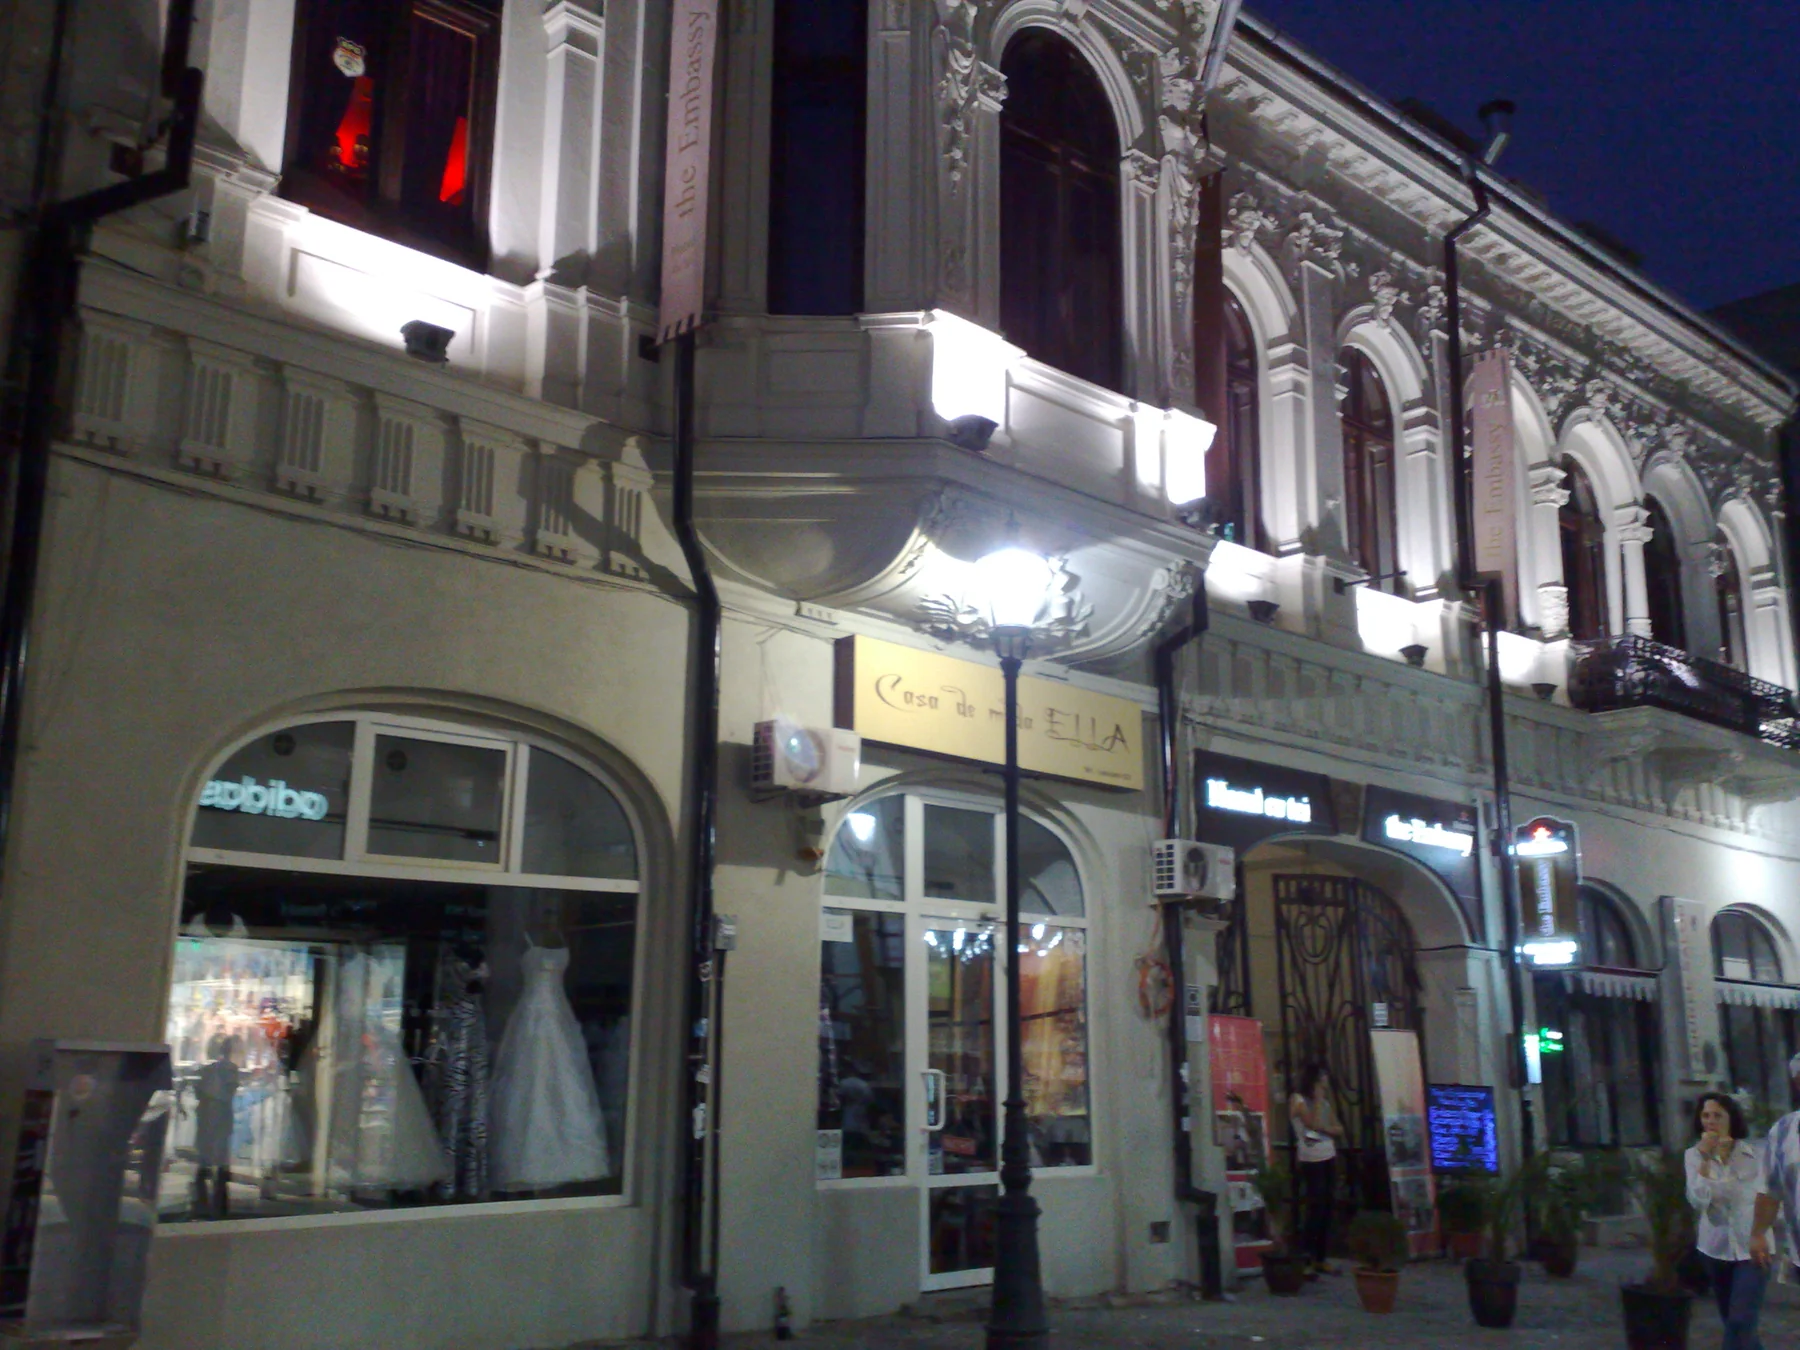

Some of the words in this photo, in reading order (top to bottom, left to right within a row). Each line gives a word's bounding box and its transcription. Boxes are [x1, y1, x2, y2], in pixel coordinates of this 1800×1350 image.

[677, 10, 710, 154] Embassy
[674, 164, 697, 219] the
[1483, 423, 1504, 515] Embassy
[875, 673, 938, 713] Casa
[940, 685, 976, 719] de
[988, 701, 1033, 730] mda
